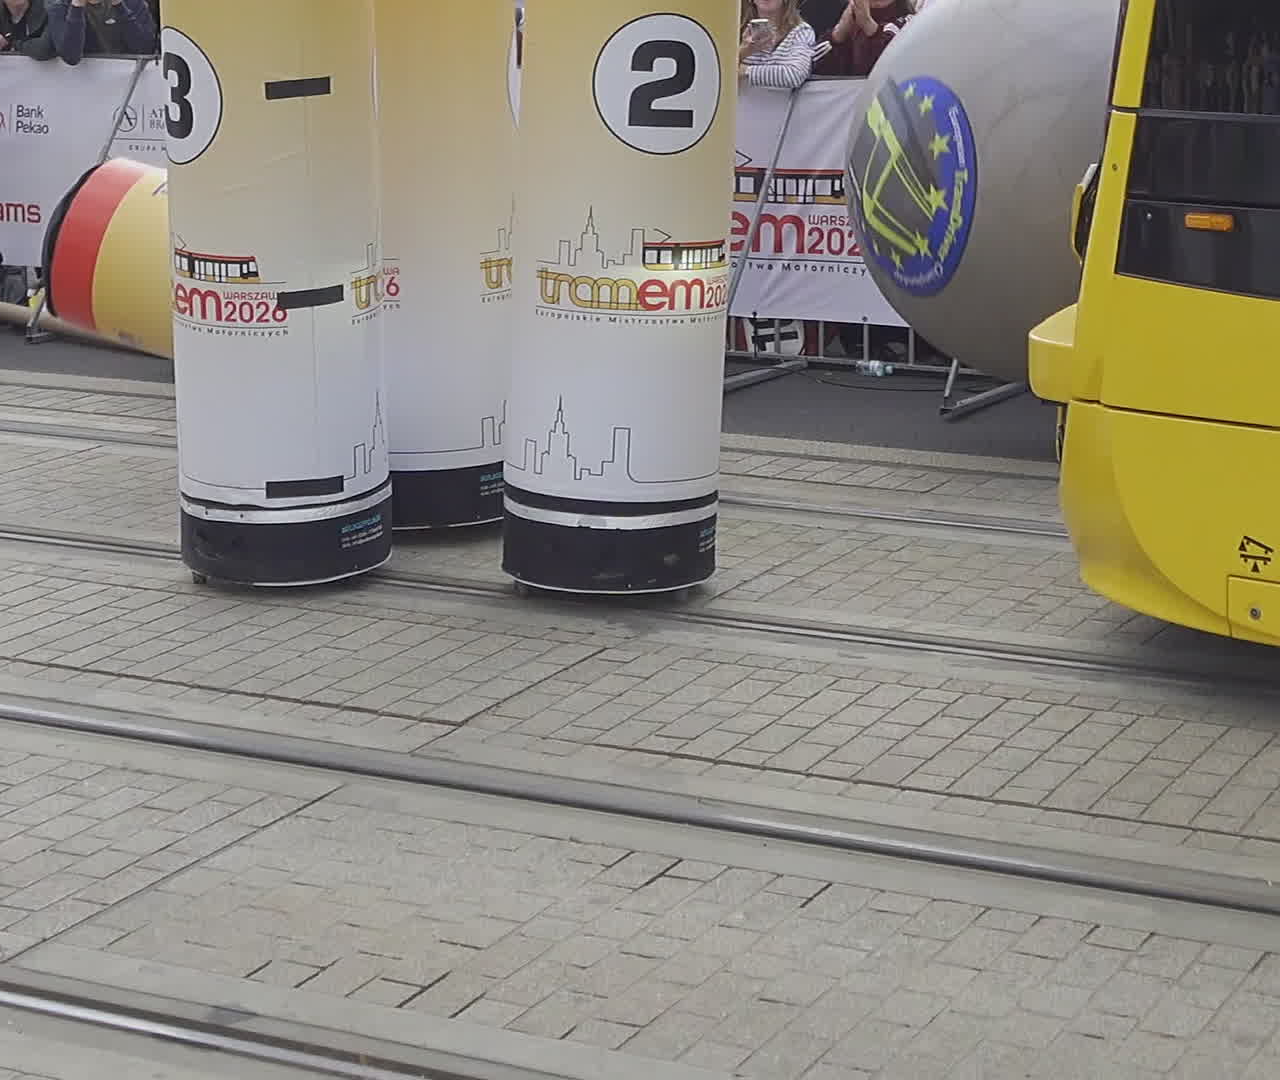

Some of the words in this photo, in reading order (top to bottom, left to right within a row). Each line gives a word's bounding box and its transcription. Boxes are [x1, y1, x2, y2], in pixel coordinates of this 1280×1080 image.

[629, 40, 695, 128] 2
[162, 52, 194, 139] 3
[16, 104, 44, 119] Bank
[16, 120, 49, 134] Pekao
[808, 227, 864, 257] 202
[782, 263, 867, 277] Motorniczy
[223, 292, 278, 301] WARSZAW
[223, 301, 288, 323] 2026
